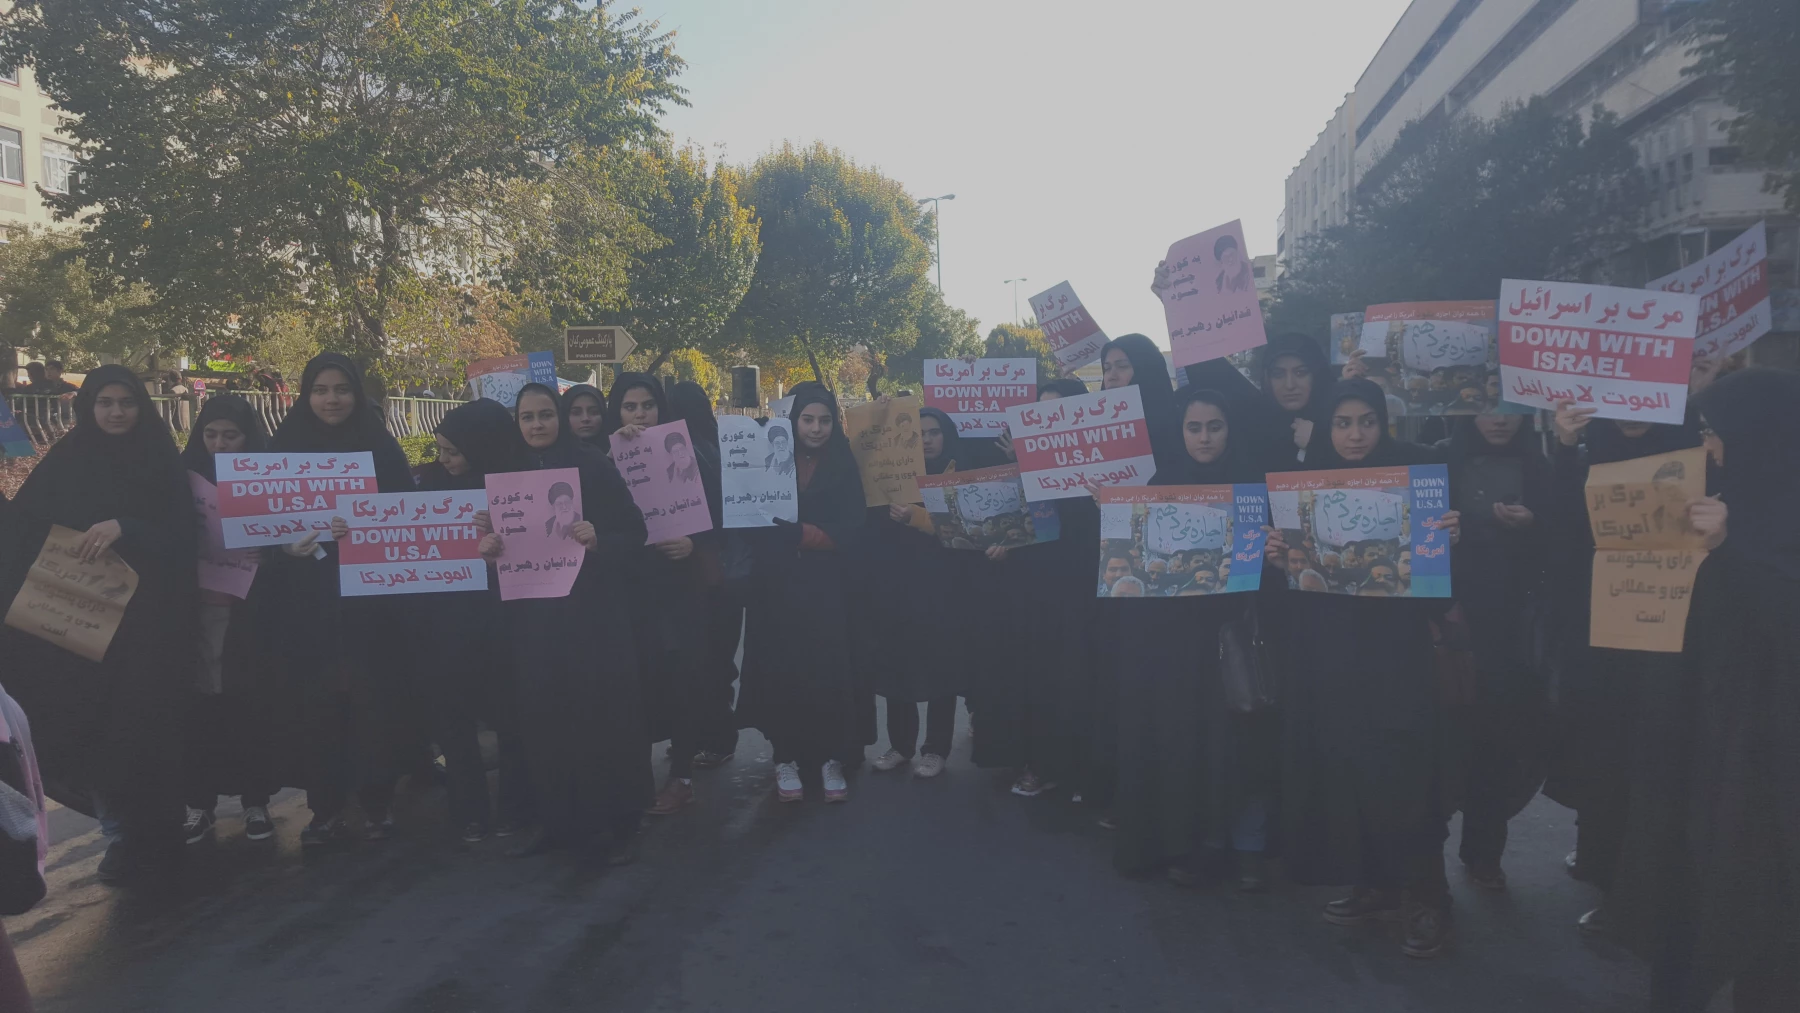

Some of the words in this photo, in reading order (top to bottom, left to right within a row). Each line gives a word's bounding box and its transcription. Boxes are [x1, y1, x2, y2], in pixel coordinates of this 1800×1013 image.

[1192, 255, 1202, 264] به
[1730, 240, 1757, 267] مرگ
[1714, 260, 1726, 285] بر
[1722, 265, 1760, 302] WITH
[1508, 286, 1592, 320] اسرائیل
[1048, 310, 1084, 334] WITH
[1595, 302, 1619, 324] بر
[1627, 299, 1684, 330] مرگ
[1171, 321, 1212, 340] رهبریم
[1511, 326, 1590, 350] DOWN
[1600, 332, 1675, 358] WITH
[532, 360, 552, 368] DOWN
[994, 363, 1026, 380] مرگ
[1532, 350, 1631, 378] ISRAEL
[978, 367, 990, 380] بر
[934, 386, 982, 398] DOWN
[987, 386, 1028, 398] WITH
[1601, 391, 1670, 411] الموت
[958, 400, 1000, 412] U.S.A
[1089, 396, 1128, 418] مرگ
[1020, 404, 1065, 429] امریکا
[1072, 406, 1084, 425] بر
[720, 431, 744, 442] کوری
[746, 432, 756, 441] به
[1025, 432, 1078, 452] DOWN
[1083, 423, 1136, 444] WITH
[617, 446, 640, 461] کوری
[644, 446, 653, 455] به
[1054, 447, 1104, 466] U.S.A
[232, 457, 288, 476] امریکا
[295, 460, 311, 474] بر
[317, 457, 359, 474] مرگ
[1094, 465, 1138, 484] الموت
[232, 480, 301, 497] DOWN
[307, 478, 365, 491] WITH
[1038, 472, 1088, 490] لامریکا
[1412, 478, 1444, 488] DOWN
[491, 492, 520, 505] کوری
[524, 492, 534, 503] به
[724, 492, 758, 504] رهبریم
[1236, 496, 1264, 504] DOWN
[1416, 489, 1442, 498] WITH
[1592, 492, 1606, 512] بر
[1610, 484, 1646, 508] مرگ
[268, 495, 328, 512] U.S.A
[352, 498, 405, 522] امریکا
[411, 503, 427, 520] بر
[432, 497, 474, 520] مرگ
[1238, 505, 1262, 513] WITH
[1416, 500, 1444, 509] U.S.A
[1239, 514, 1264, 522] U.S.A
[1594, 512, 1650, 540] آمریکا
[243, 519, 307, 537] لامریکا
[352, 528, 416, 544] DOWN
[423, 526, 477, 540] WITH
[385, 545, 442, 561] U.S.A
[424, 566, 473, 584] الموت
[499, 560, 540, 574] رهبریم
[359, 568, 420, 587] لامریکا
[1635, 608, 1666, 623] است
